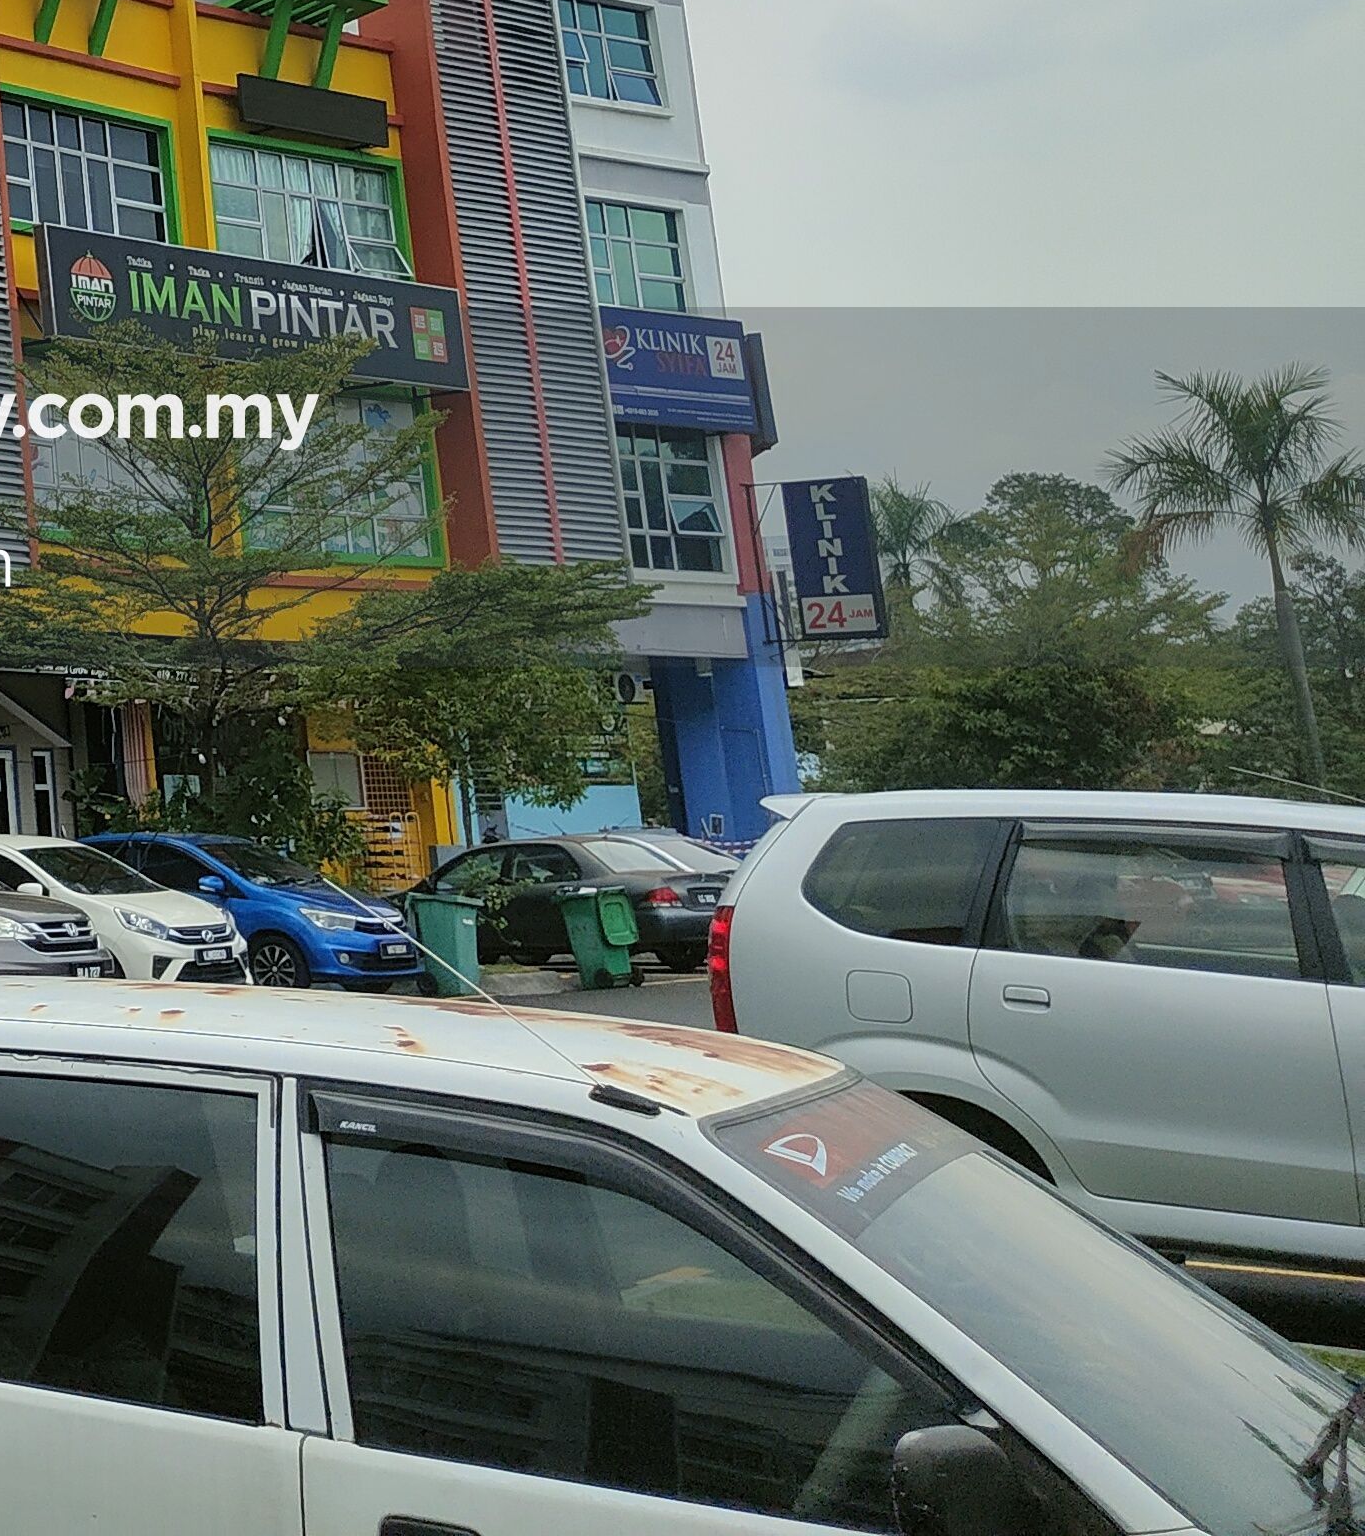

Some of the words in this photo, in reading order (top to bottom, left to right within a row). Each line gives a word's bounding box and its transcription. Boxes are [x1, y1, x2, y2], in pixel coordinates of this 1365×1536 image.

[234, 272, 265, 286] Transit
[77, 294, 112, 309] PINTAR
[129, 270, 243, 328] IMAN
[249, 288, 399, 349] PINTAR
[225, 328, 254, 343] learn
[260, 334, 267, 344] &
[272, 337, 298, 349] grow
[635, 327, 705, 355] KLINIK
[714, 341, 735, 362] 24
[717, 362, 737, 374] JAM
[809, 484, 850, 594] KLINIK
[806, 600, 847, 629] 24
[848, 607, 873, 620] JAM
